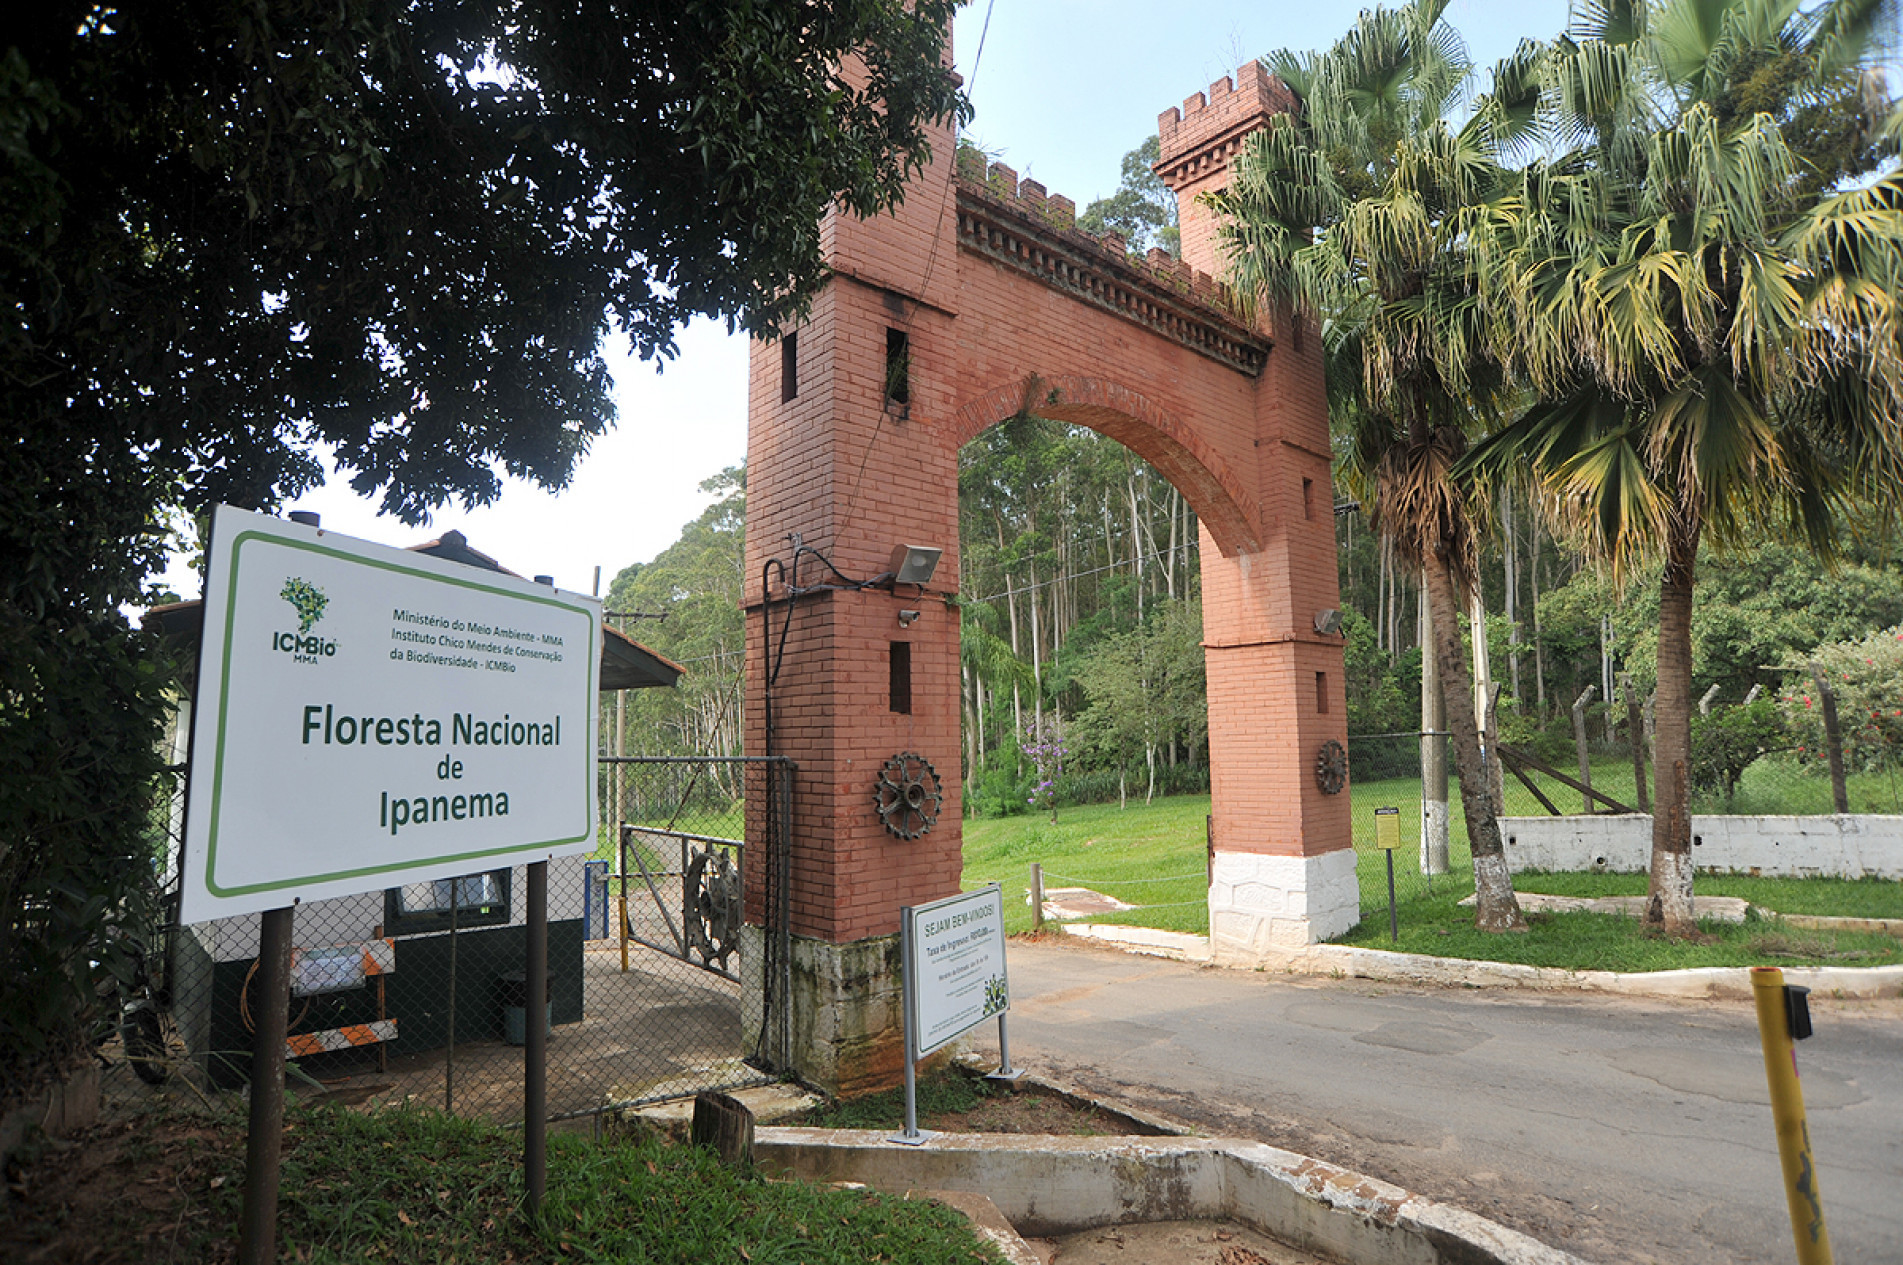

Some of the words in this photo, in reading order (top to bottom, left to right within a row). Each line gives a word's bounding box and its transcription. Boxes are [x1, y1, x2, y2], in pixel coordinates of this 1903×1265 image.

[393, 609, 450, 629] Ministério
[452, 619, 466, 632] do
[467, 622, 492, 636] Meio
[493, 625, 536, 643] Ambiente
[542, 633, 564, 647] MMA
[272, 631, 336, 657] ICMBio
[391, 628, 437, 646] Instituto
[438, 634, 464, 650] Chico
[466, 639, 502, 655] Mendes
[503, 644, 514, 656] de
[514, 646, 563, 663] Conservação
[293, 654, 318, 664] MMA
[389, 648, 404, 661] da
[406, 650, 478, 670] Biodiversidade
[485, 659, 516, 673] ICMBio
[302, 703, 442, 746] Floresta
[452, 712, 561, 746] Nacional
[436, 753, 464, 780] de
[380, 791, 510, 836] Ipanema
[924, 917, 951, 938] SEJAM
